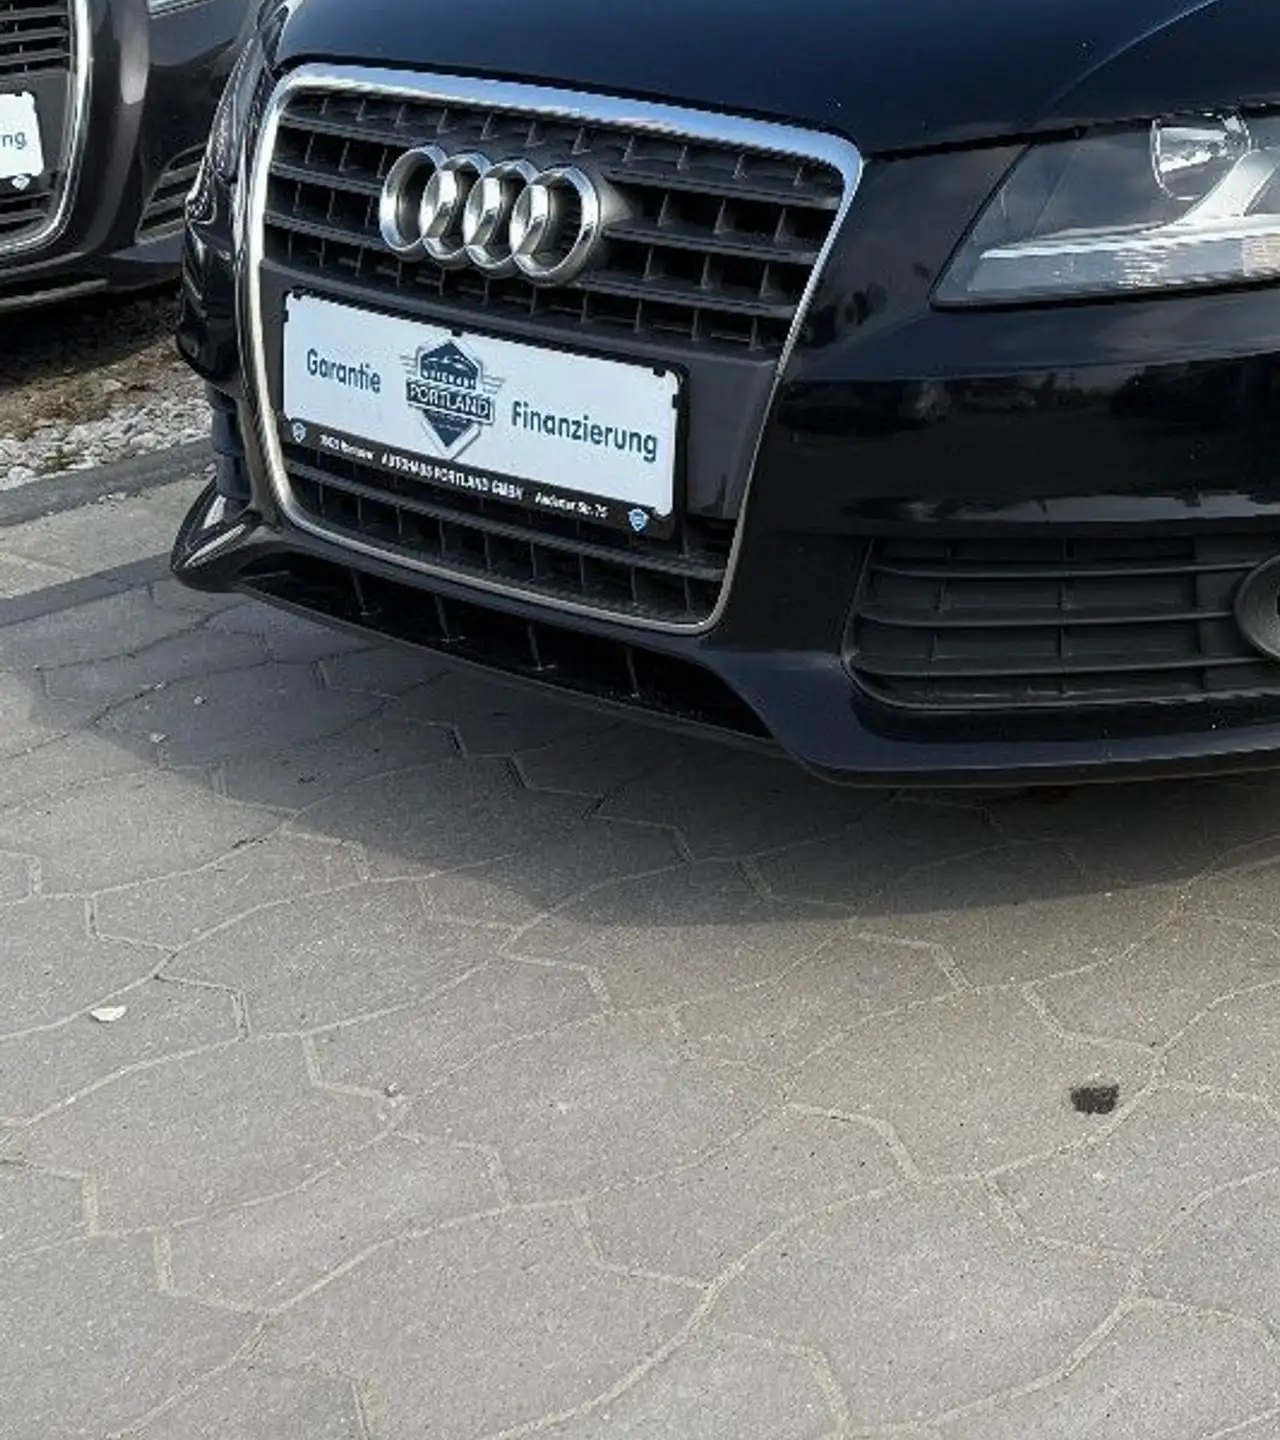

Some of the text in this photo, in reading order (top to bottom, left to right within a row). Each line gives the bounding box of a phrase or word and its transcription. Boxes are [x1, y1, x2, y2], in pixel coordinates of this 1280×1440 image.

[306, 347, 381, 394] Garantie
[409, 383, 489, 416] PORTLAND
[511, 400, 658, 464] Finanzierung
